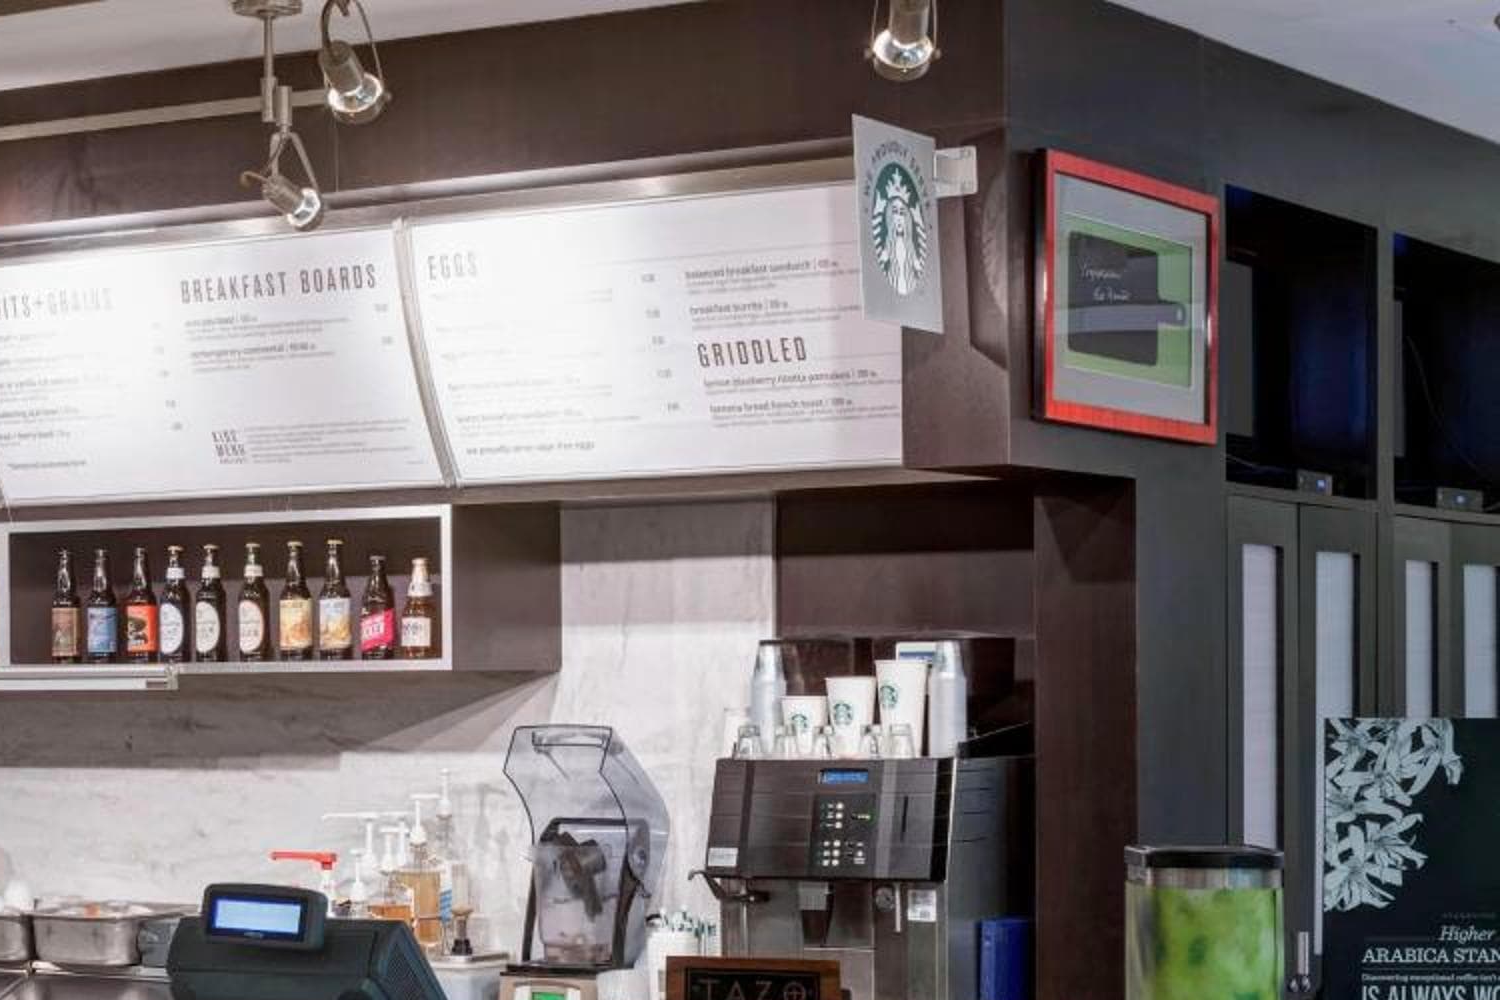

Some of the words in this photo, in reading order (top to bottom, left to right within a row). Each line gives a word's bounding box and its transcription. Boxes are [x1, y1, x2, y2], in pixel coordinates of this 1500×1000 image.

[427, 250, 478, 281] EGGS
[180, 271, 287, 304] BREAKFAST
[299, 263, 377, 294] BOARDS
[696, 336, 807, 368] GRIDDLED
[1439, 925, 1497, 944] Higher
[1362, 947, 1449, 963] ARABICA
